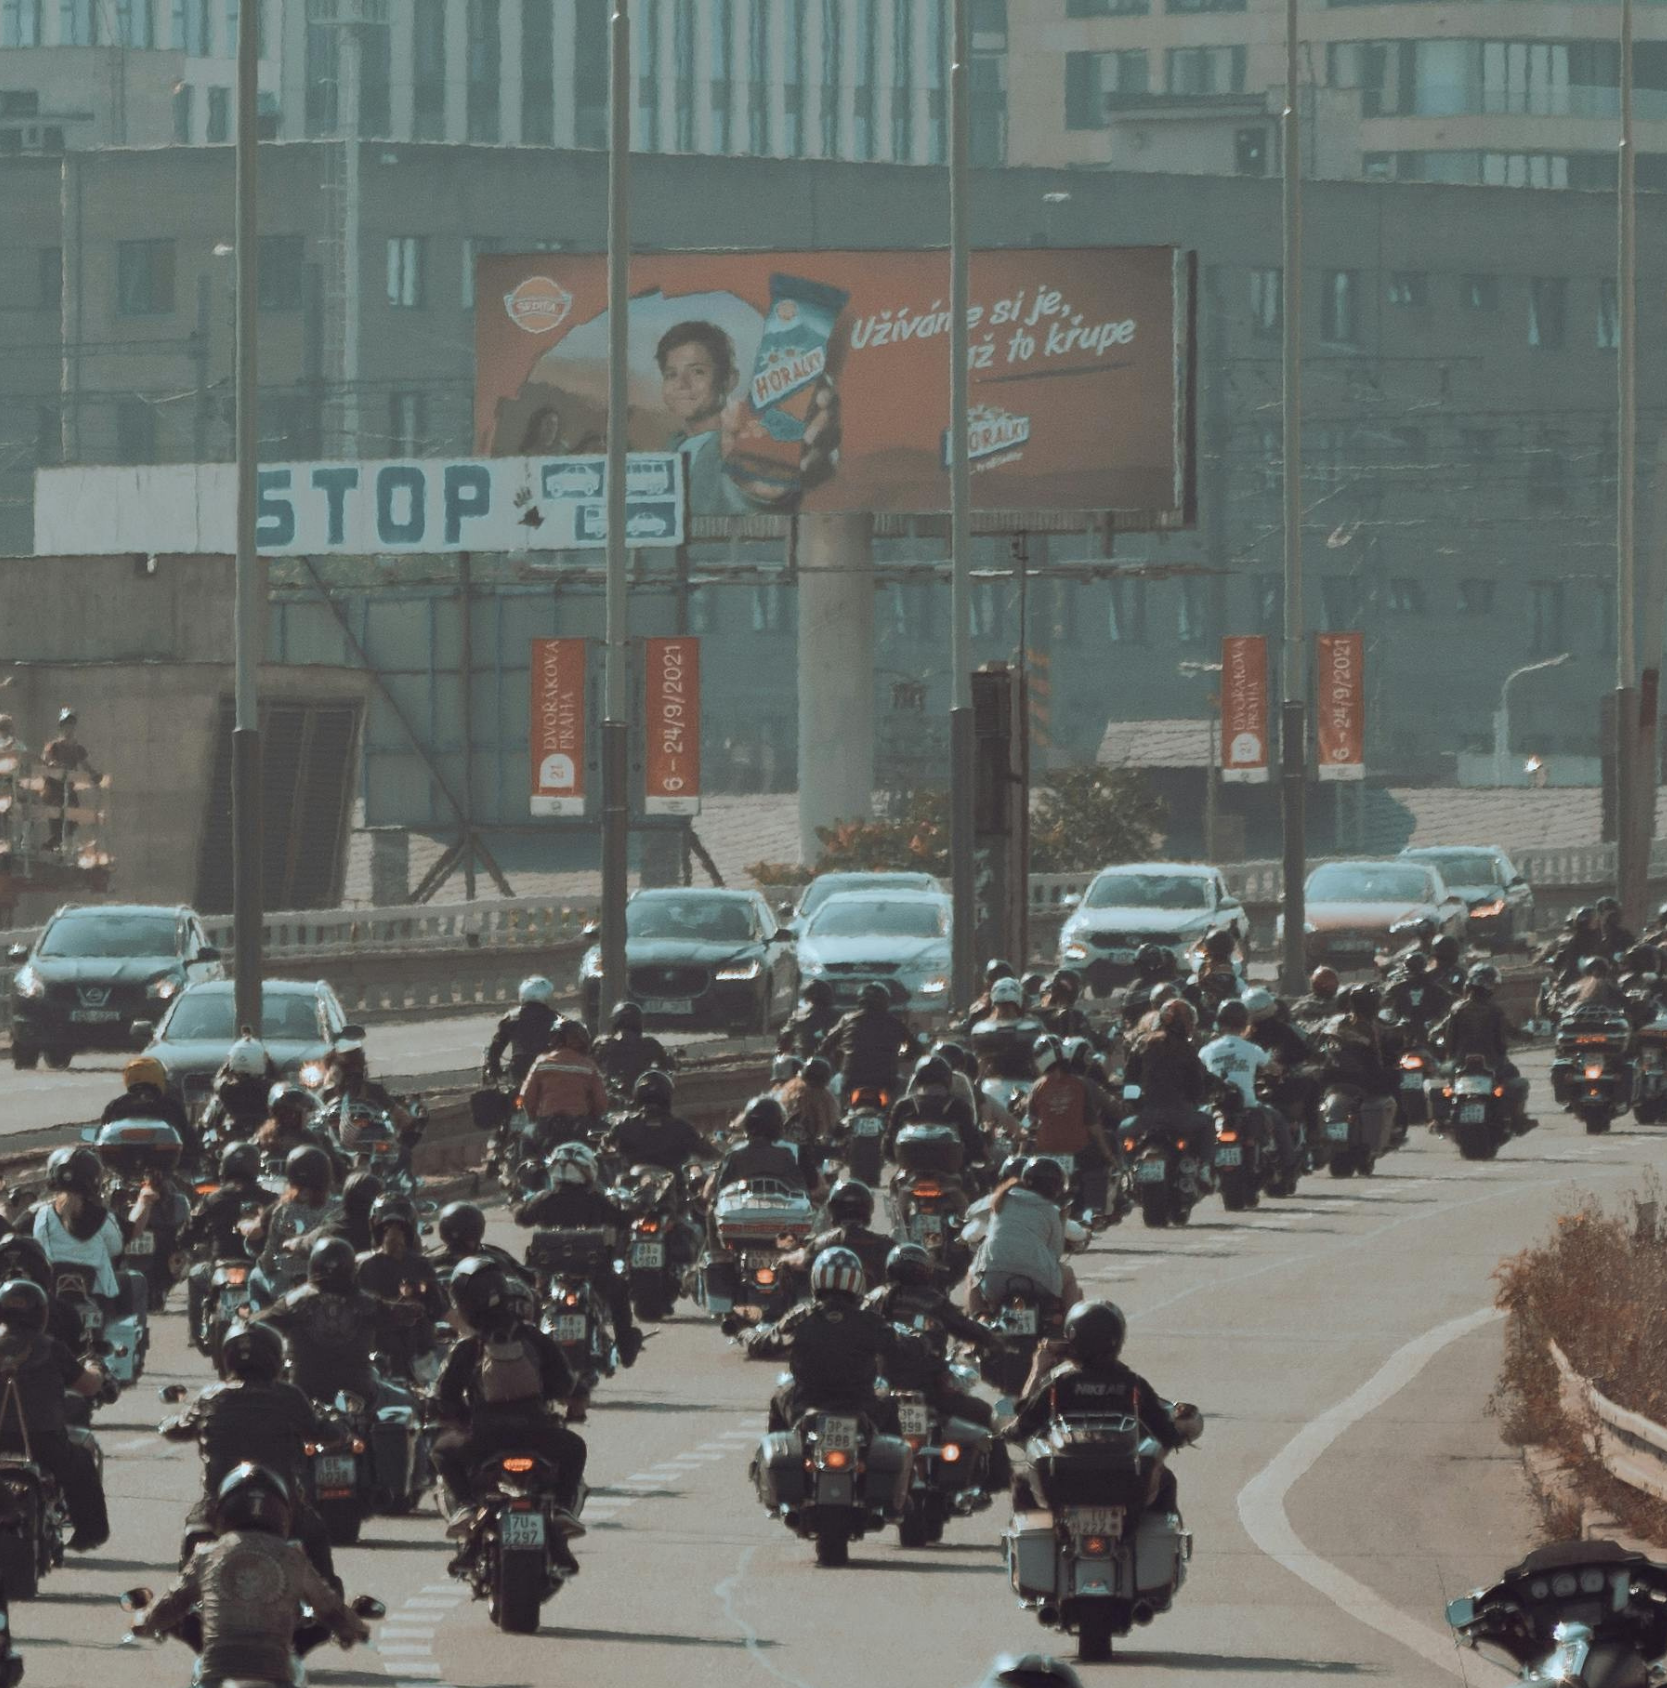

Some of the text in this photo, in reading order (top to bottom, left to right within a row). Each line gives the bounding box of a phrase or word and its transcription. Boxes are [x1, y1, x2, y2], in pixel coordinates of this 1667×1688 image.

[989, 291, 1024, 325] si
[1007, 330, 1035, 363] to
[1045, 314, 1137, 356] křupe
[257, 465, 490, 547] STOP
[662, 645, 685, 753] 24/9/2021
[663, 777, 683, 791] 6
[504, 1531, 539, 1545] 2297
[512, 1517, 529, 1529] 7U
